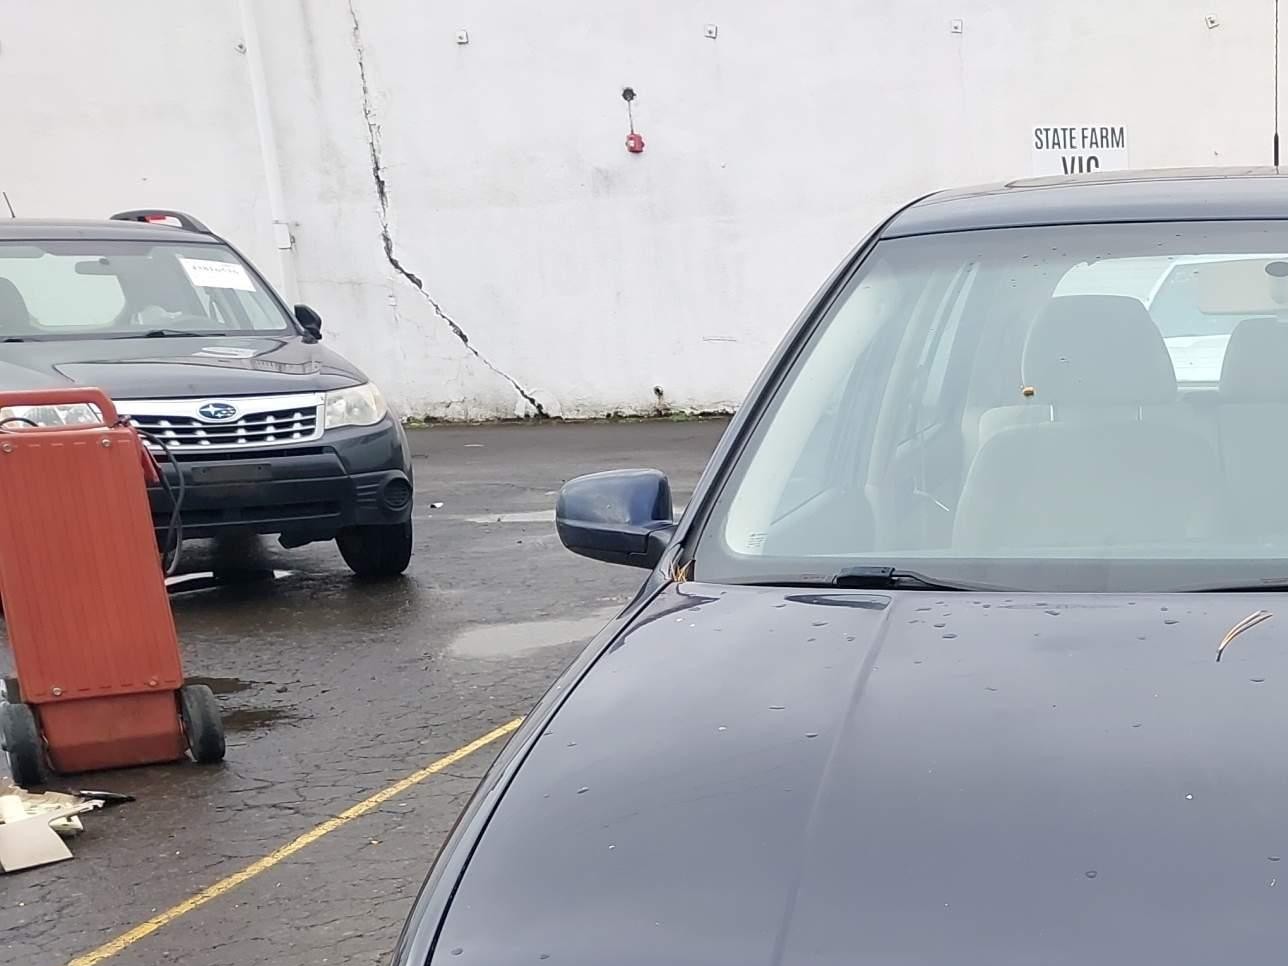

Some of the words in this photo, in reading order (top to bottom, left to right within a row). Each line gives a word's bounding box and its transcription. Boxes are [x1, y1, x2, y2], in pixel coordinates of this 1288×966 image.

[1034, 127, 1077, 150] STATE
[1081, 126, 1125, 149] FARM
[1061, 155, 1099, 175] VIC
